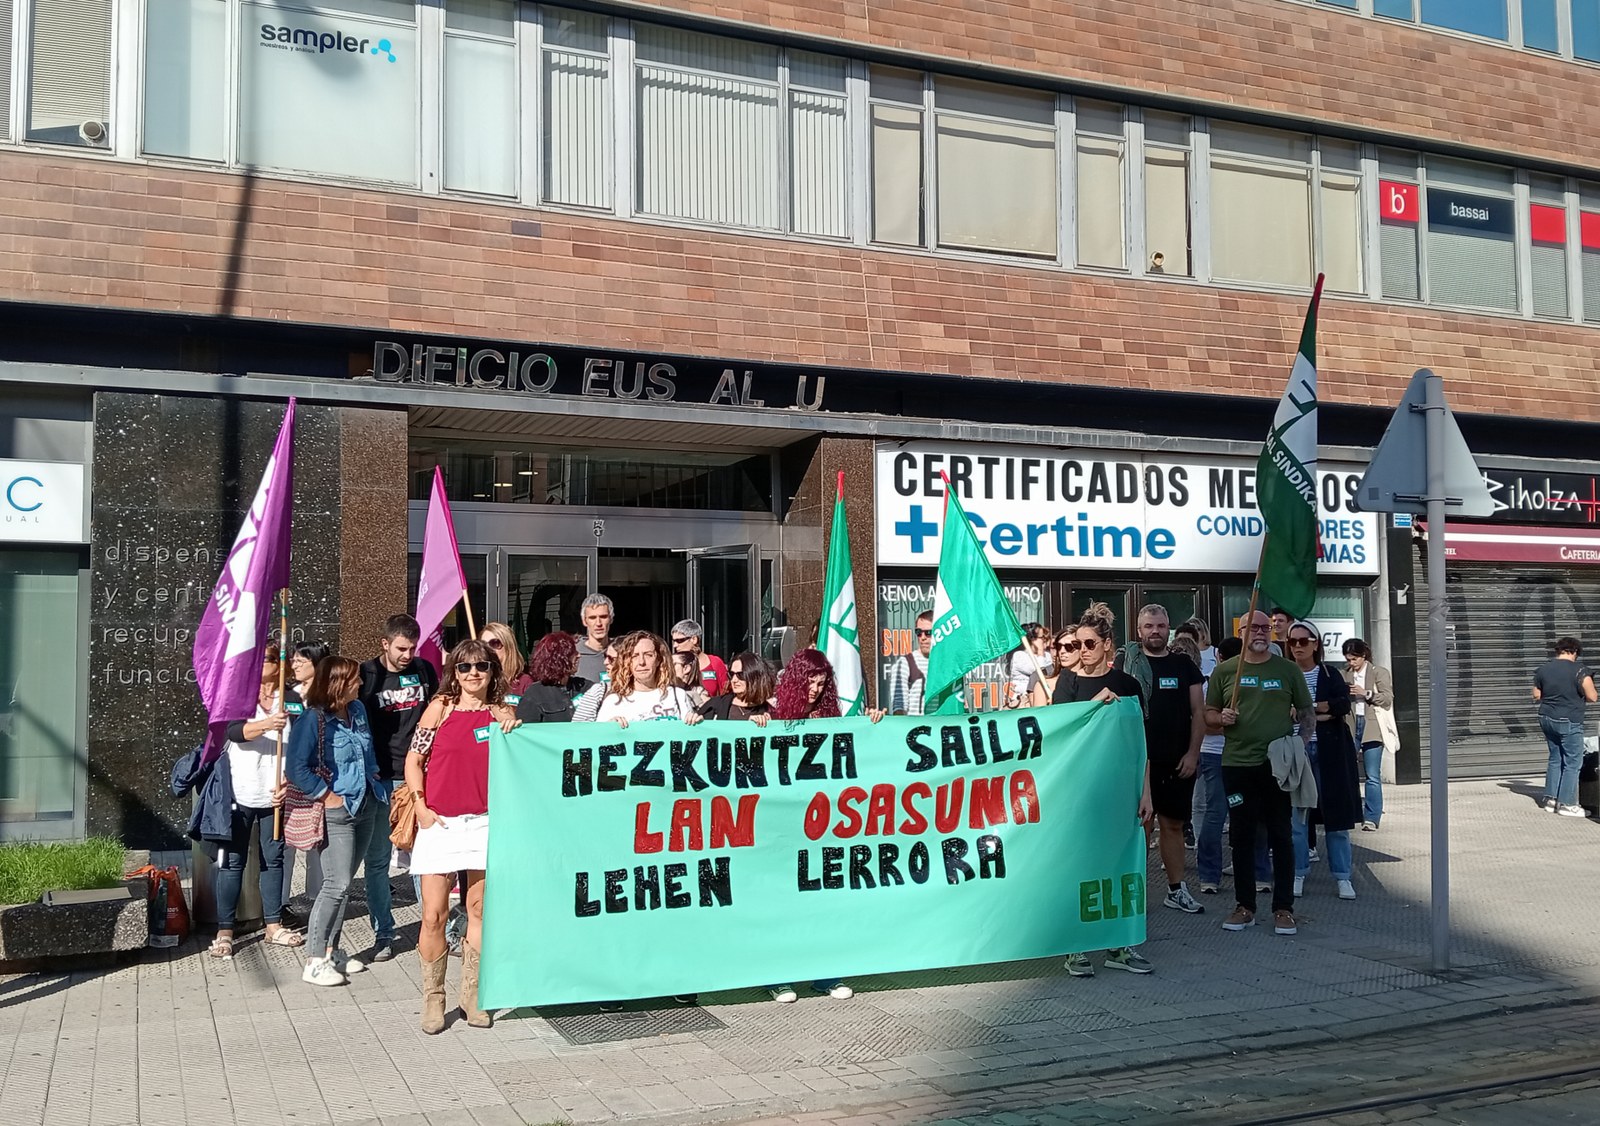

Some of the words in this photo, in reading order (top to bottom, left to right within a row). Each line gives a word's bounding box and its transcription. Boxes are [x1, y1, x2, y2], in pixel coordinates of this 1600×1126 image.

[260, 24, 370, 54] sampler
[1451, 203, 1490, 221] bassai
[894, 452, 1190, 507] CERTIFICADOS
[1272, 450, 1317, 518] SINDIKA
[882, 629, 912, 656] SIN
[561, 732, 858, 798] HEZKUNTZA
[633, 794, 761, 855] LAN
[803, 769, 1042, 841] OSASUNA
[1228, 796, 1242, 804] ELA
[574, 856, 733, 918] LEHEN
[1078, 872, 1145, 923] ELA
